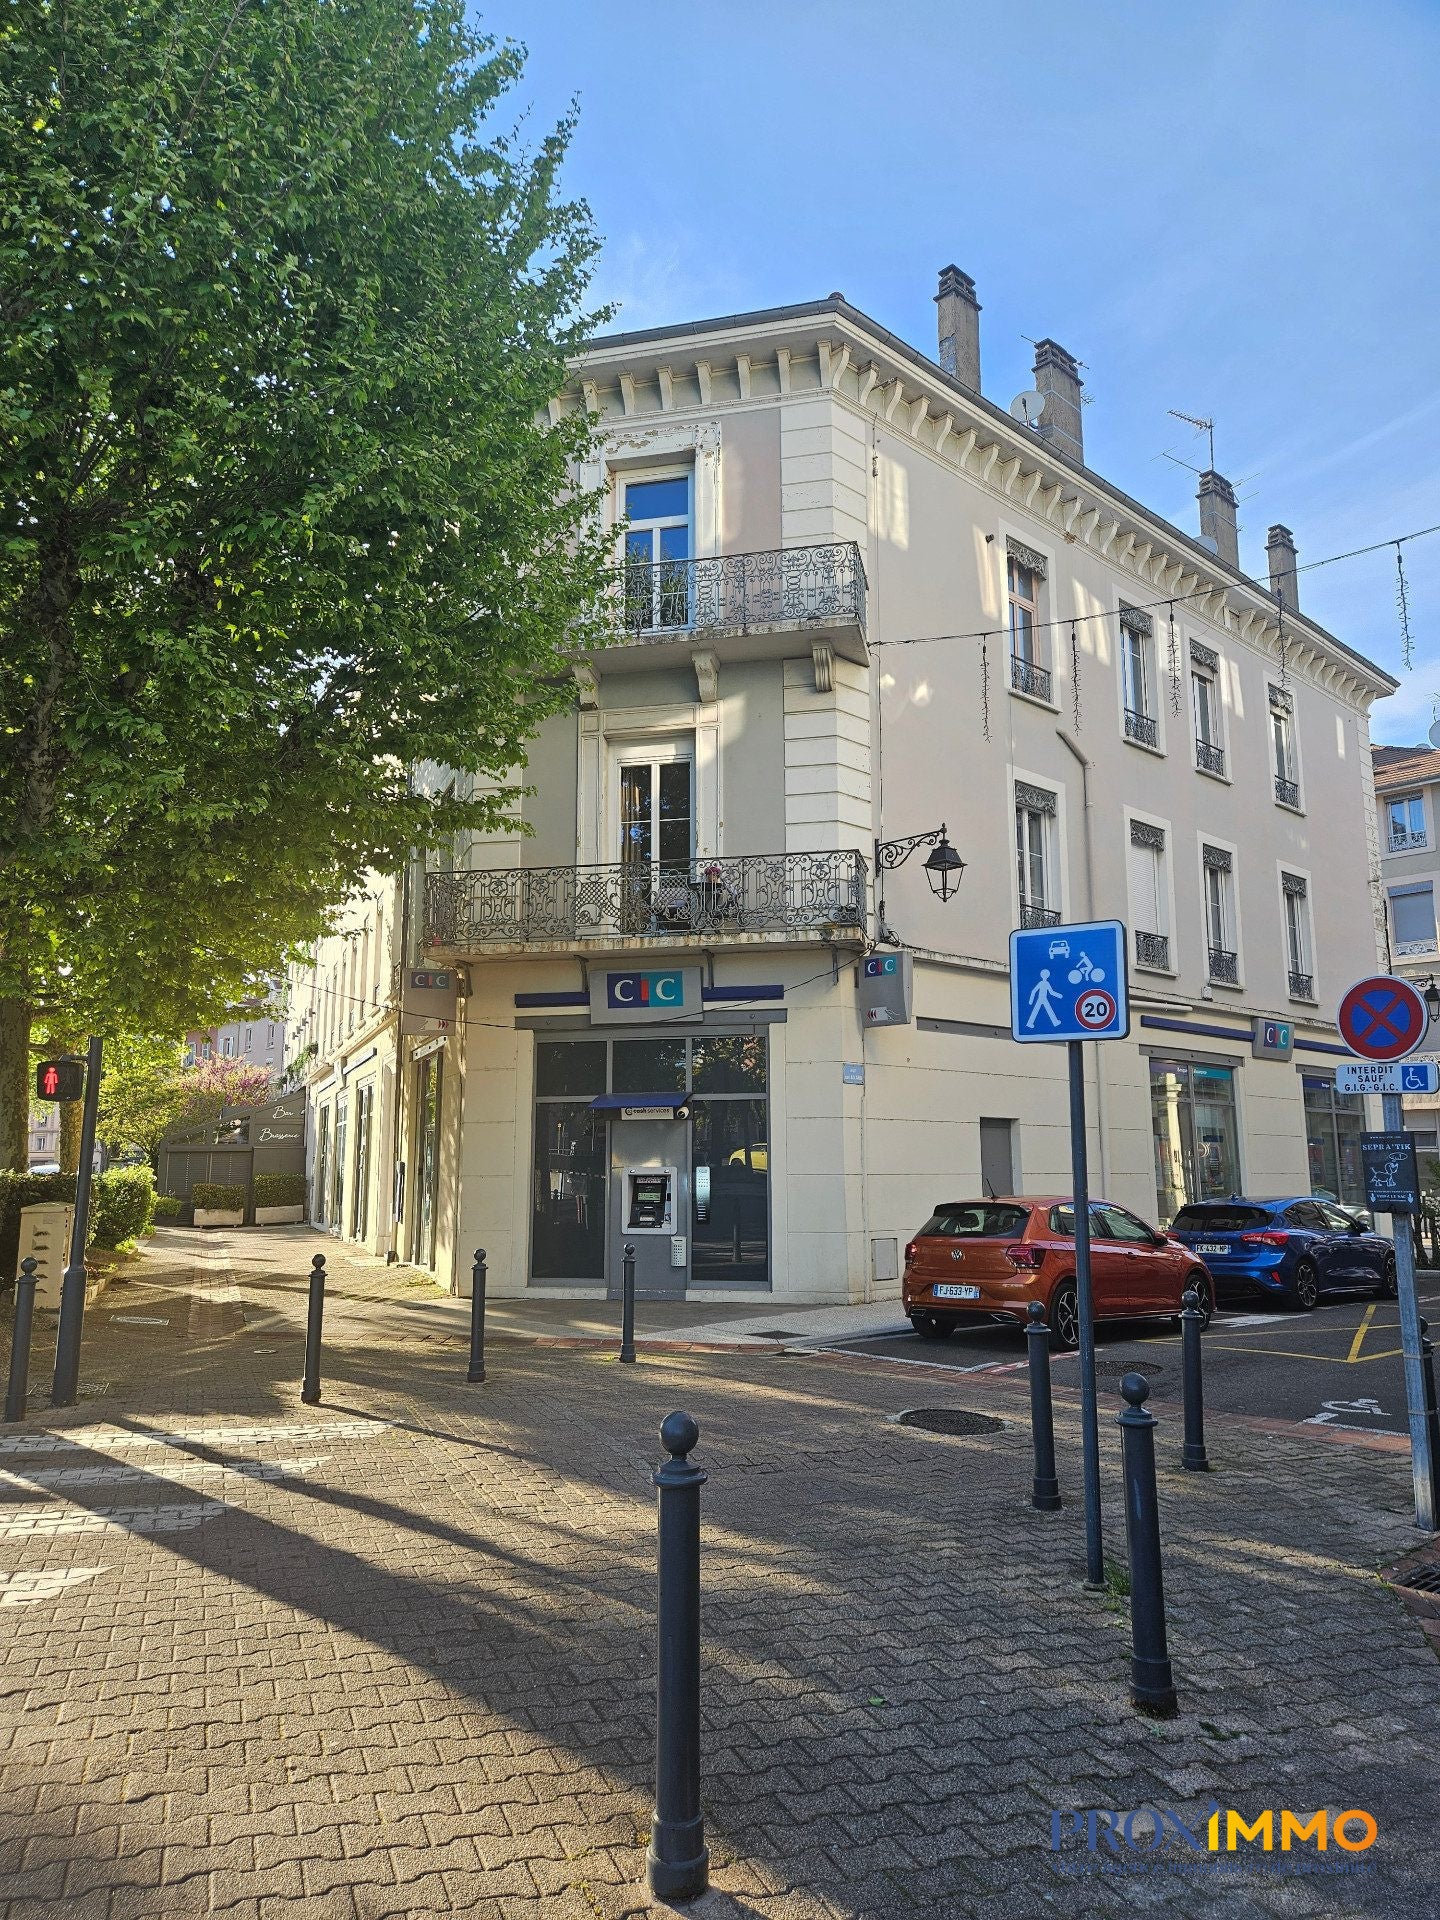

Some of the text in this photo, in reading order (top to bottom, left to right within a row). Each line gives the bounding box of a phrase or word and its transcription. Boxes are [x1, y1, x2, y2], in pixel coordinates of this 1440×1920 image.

[867, 959, 894, 974] CIC
[414, 974, 446, 987] CIC
[614, 977, 675, 1002] CIC
[1084, 1001, 1108, 1018] 20
[1266, 1027, 1288, 1045] CIC
[1347, 1065, 1394, 1075] INTERDIT
[1358, 1074, 1384, 1083] SAUF
[1344, 1083, 1399, 1092] G.I.G.-G.I.C.
[272, 1105, 294, 1119] Bar
[259, 1127, 301, 1142] Brasserie
